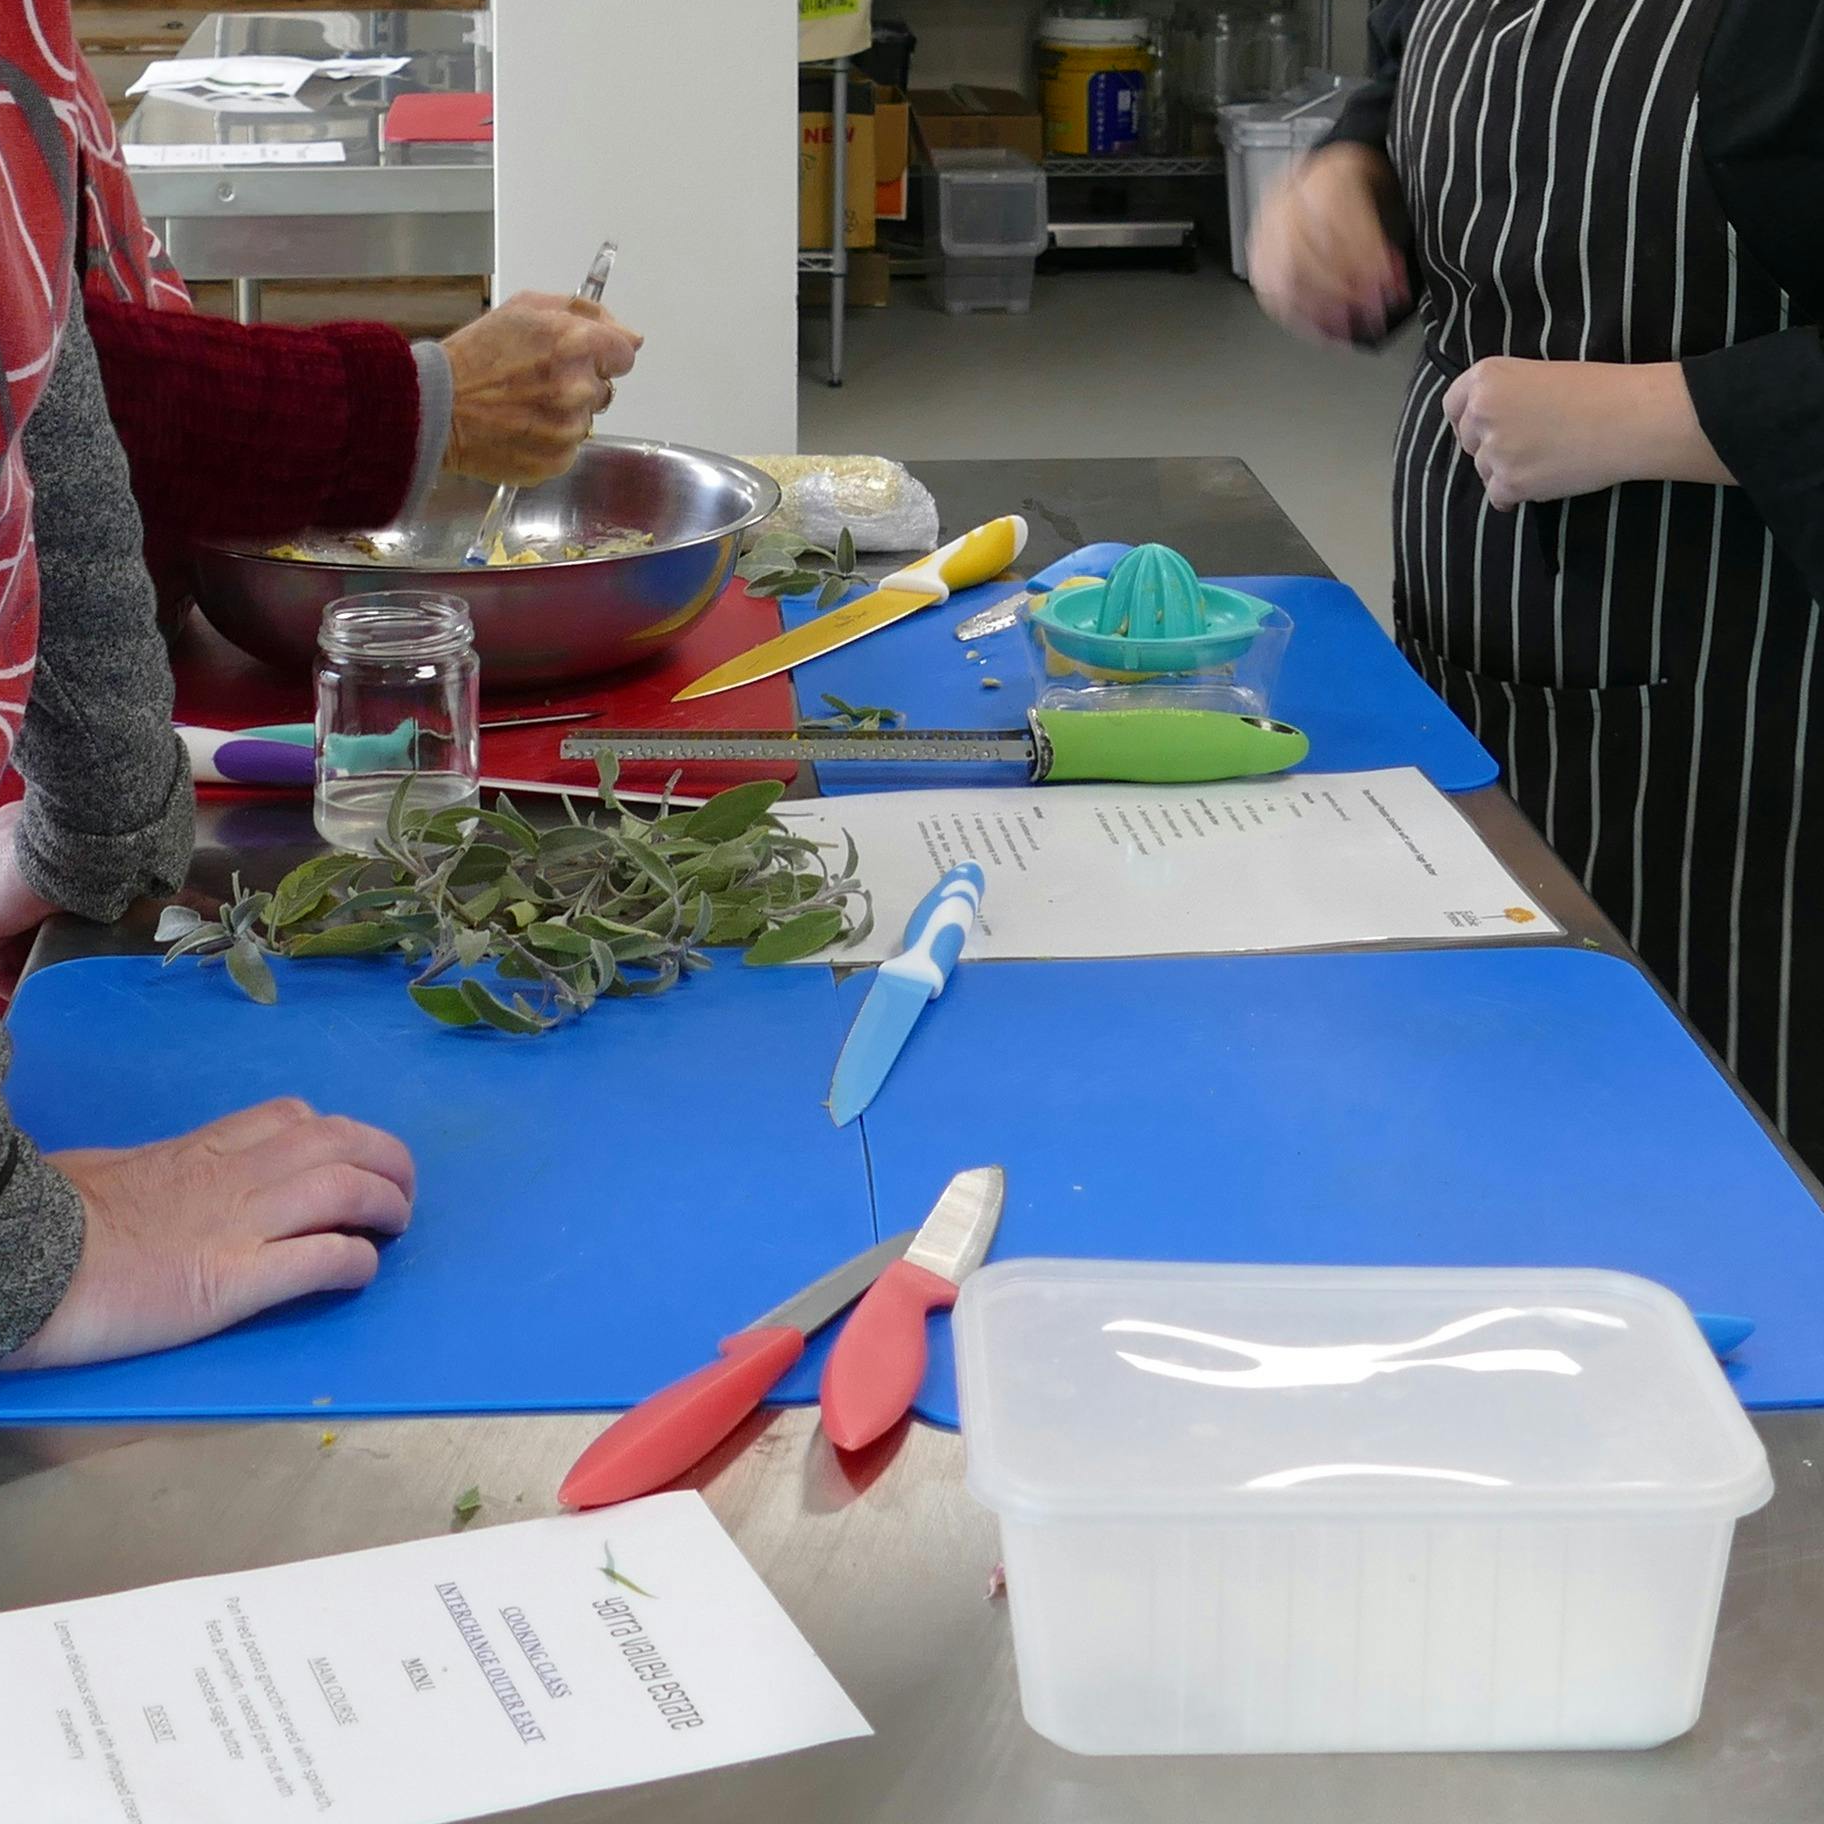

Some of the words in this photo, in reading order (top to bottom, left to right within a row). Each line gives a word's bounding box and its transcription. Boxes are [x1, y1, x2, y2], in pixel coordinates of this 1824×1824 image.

[222, 1595, 243, 1616] Pan
[233, 1614, 258, 1641] fried
[238, 1638, 269, 1674] potato
[436, 1581, 502, 1668] INTERCHANGE
[485, 1667, 526, 1712] OUTER
[511, 1709, 547, 1745] EAST
[501, 1605, 550, 1663] COOKING
[534, 1661, 573, 1699] CLASS
[591, 1595, 644, 1638] yarra
[618, 1635, 674, 1683] valley
[646, 1680, 705, 1731] estate
[192, 1666, 224, 1705] roasted
[309, 1656, 339, 1687] MAIN
[403, 1657, 436, 1691] MENU
[253, 1673, 289, 1712] gnocchi
[323, 1684, 360, 1726] COURSE
[146, 1704, 177, 1742] DESERT
[208, 1703, 230, 1730] sage
[237, 1693, 268, 1733] roasted
[274, 1710, 306, 1745] served
[54, 1706, 86, 1761] strawberry
[218, 1727, 245, 1761] butter
[249, 1731, 275, 1756] pine
[264, 1754, 285, 1775] nut
[291, 1744, 315, 1769] with
[272, 1773, 297, 1799] with
